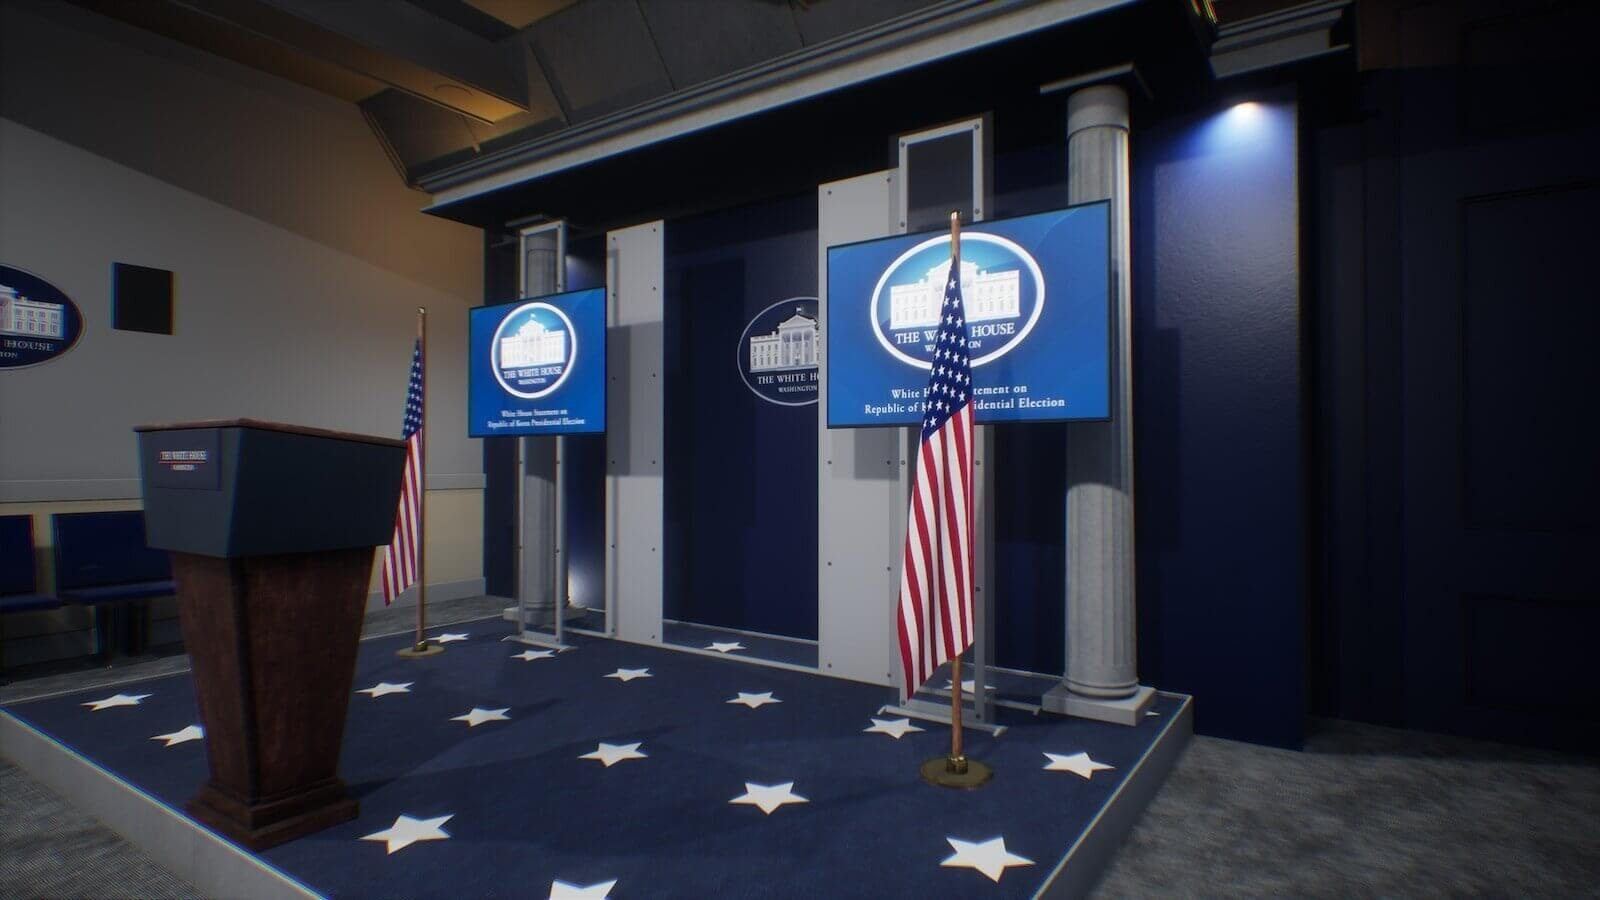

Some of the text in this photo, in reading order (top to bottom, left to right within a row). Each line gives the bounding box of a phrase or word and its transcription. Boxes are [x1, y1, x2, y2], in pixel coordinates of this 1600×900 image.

[895, 331, 920, 345] THE
[971, 322, 1015, 338] HOUSE
[4, 340, 54, 351] HOUSE
[503, 370, 516, 379] THE
[518, 367, 539, 378] WHITE
[757, 375, 774, 385] THE
[776, 373, 806, 383] WHITE
[891, 388, 920, 399] White
[973, 385, 1009, 396] tement
[1013, 384, 1028, 394] on
[864, 404, 905, 416] Republic
[907, 402, 919, 414] of
[974, 400, 1016, 411] idential
[1018, 398, 1066, 409] Election
